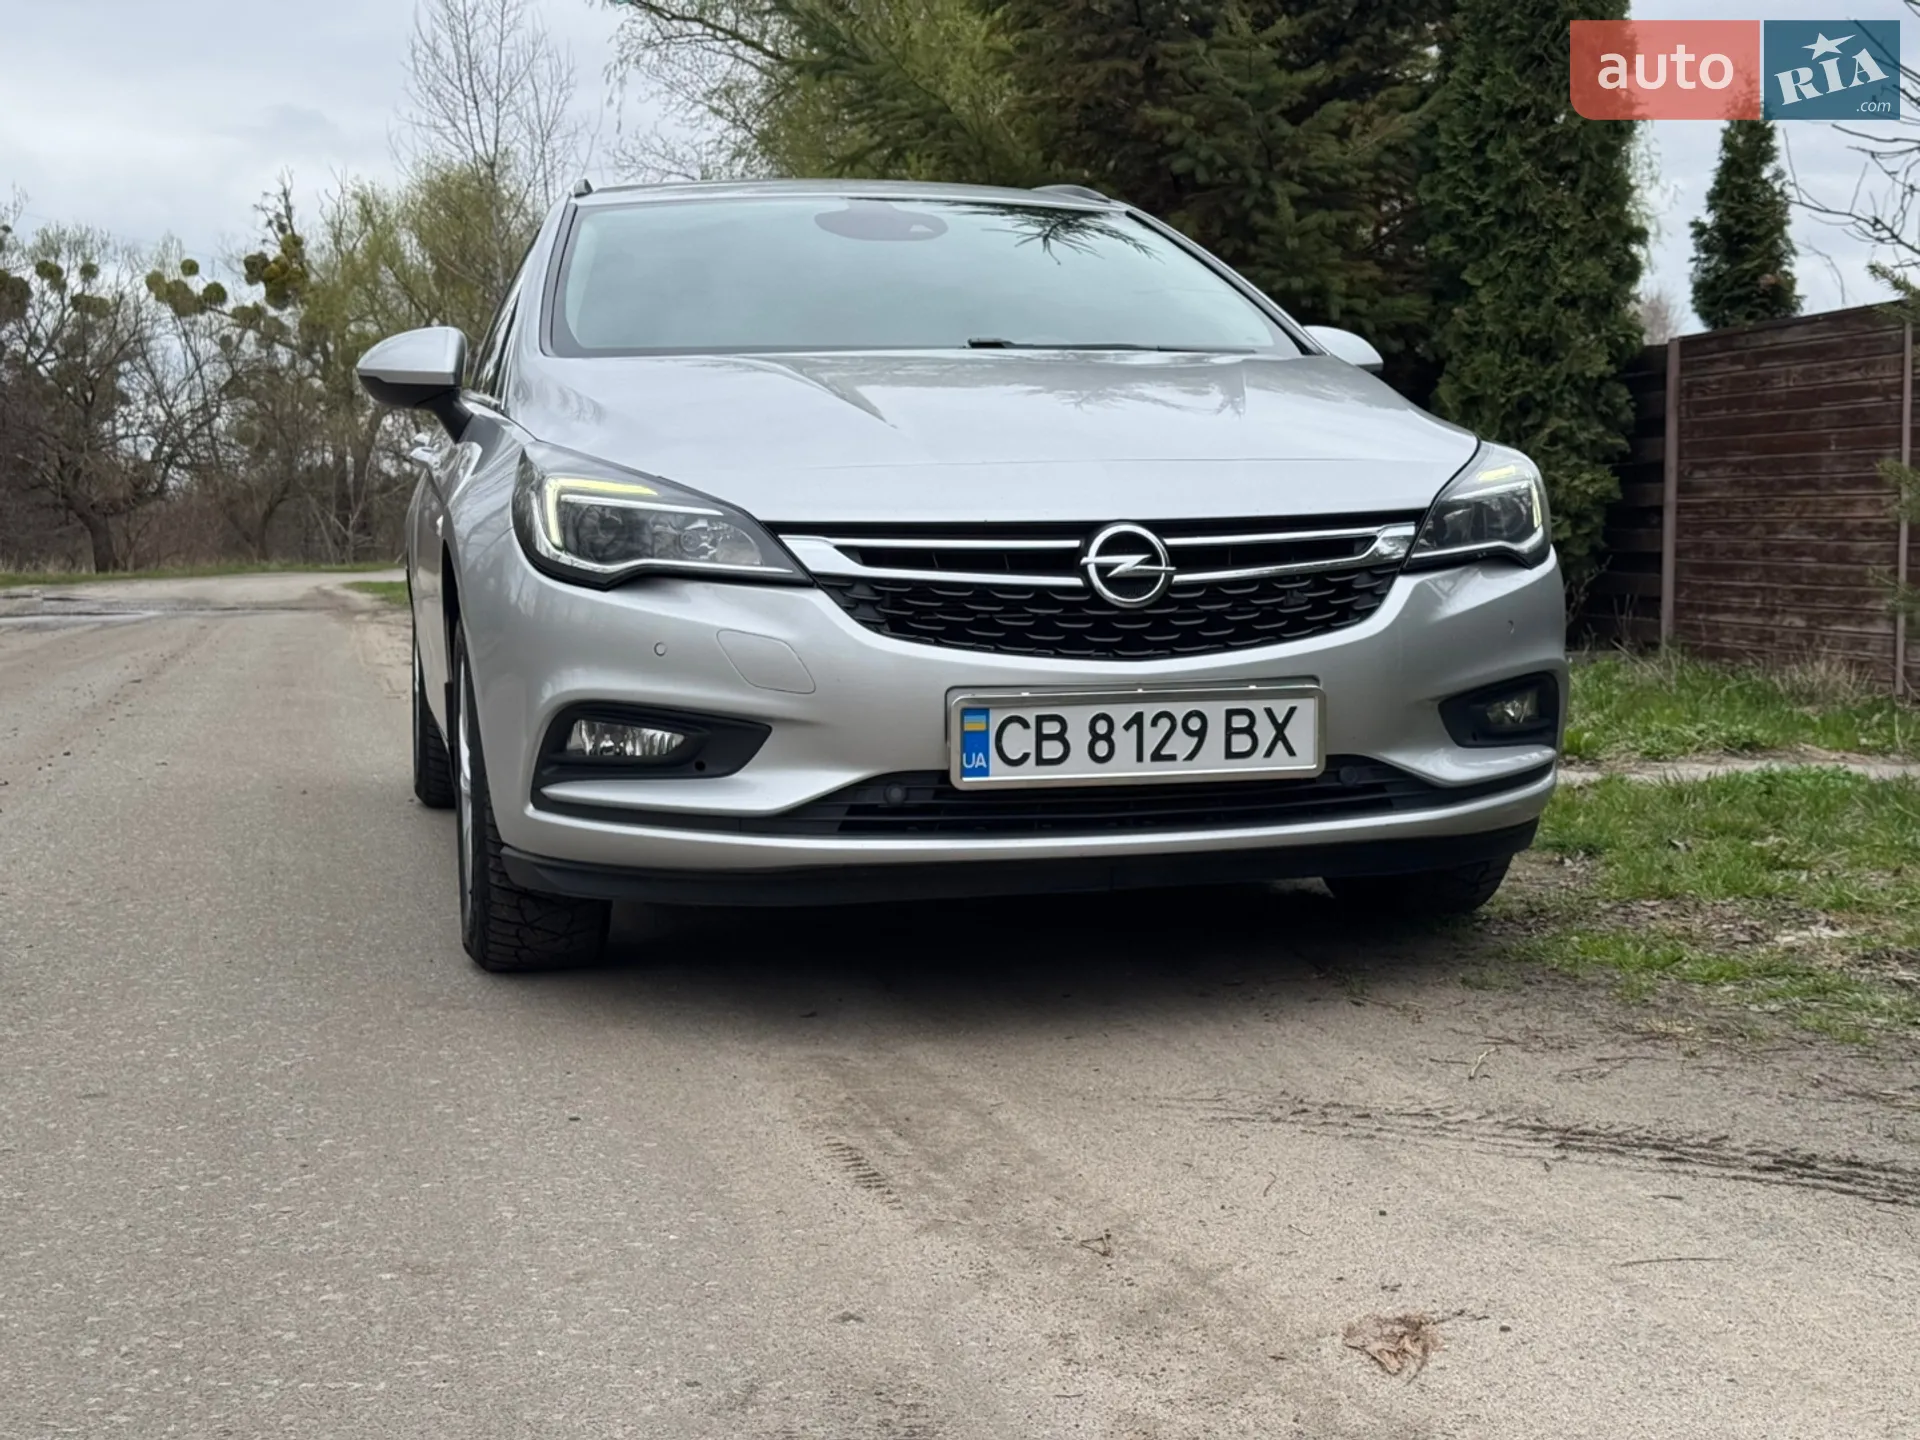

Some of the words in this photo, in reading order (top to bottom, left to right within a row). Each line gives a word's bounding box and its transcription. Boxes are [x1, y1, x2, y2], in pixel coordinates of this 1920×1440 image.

[994, 714, 1071, 767] CB
[1087, 709, 1209, 764] 8129
[1224, 706, 1298, 760] BX
[962, 752, 988, 769] UA
